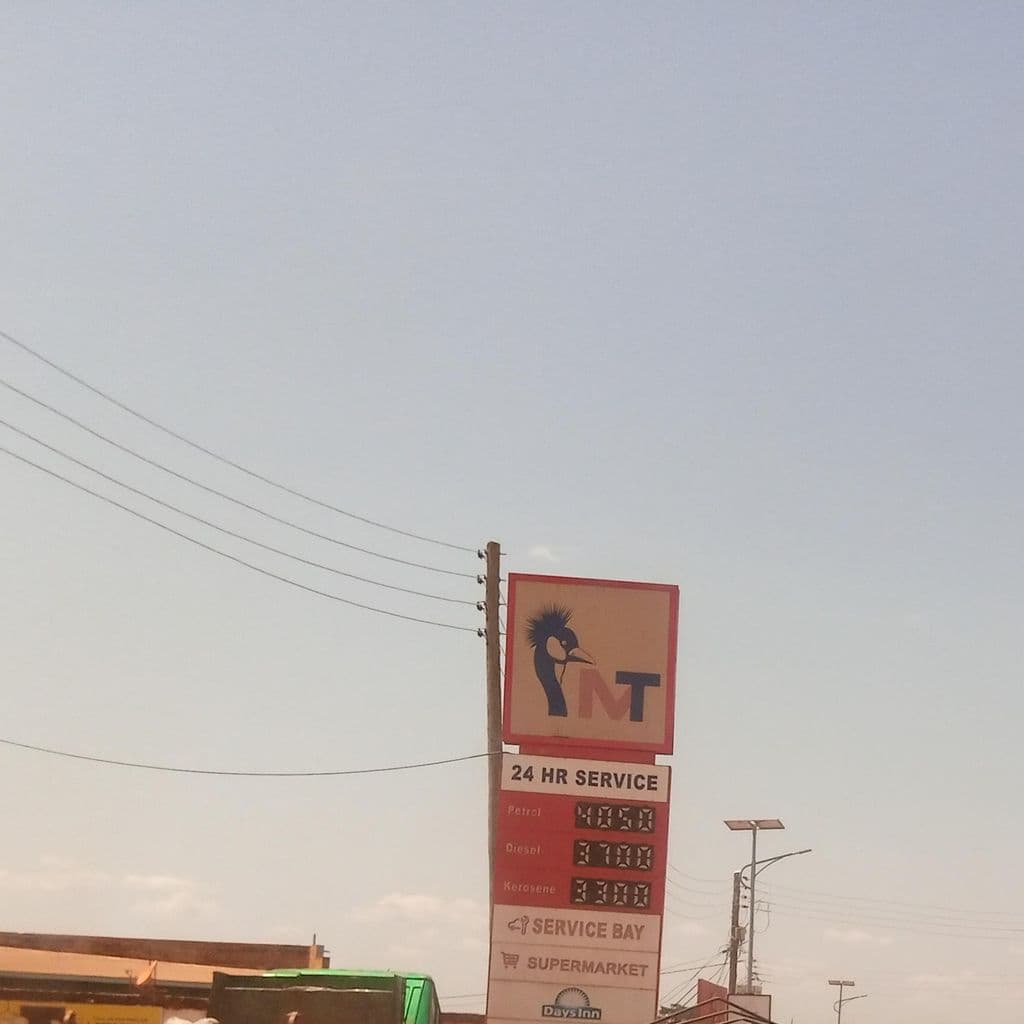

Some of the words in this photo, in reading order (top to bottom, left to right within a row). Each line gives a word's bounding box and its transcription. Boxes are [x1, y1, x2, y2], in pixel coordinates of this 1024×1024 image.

[511, 764, 535, 782] 24
[541, 767, 568, 785] HR
[575, 769, 659, 791] SERVICE
[507, 804, 542, 818] Petrol
[577, 805, 653, 832] 4050
[505, 842, 542, 856] Diesel
[577, 841, 652, 870] 3700
[503, 880, 557, 895] Kerosene
[574, 879, 650, 908] 3300
[532, 917, 608, 939] SERVICE
[612, 921, 645, 941] BAY
[527, 955, 649, 977] SUPERMARKET
